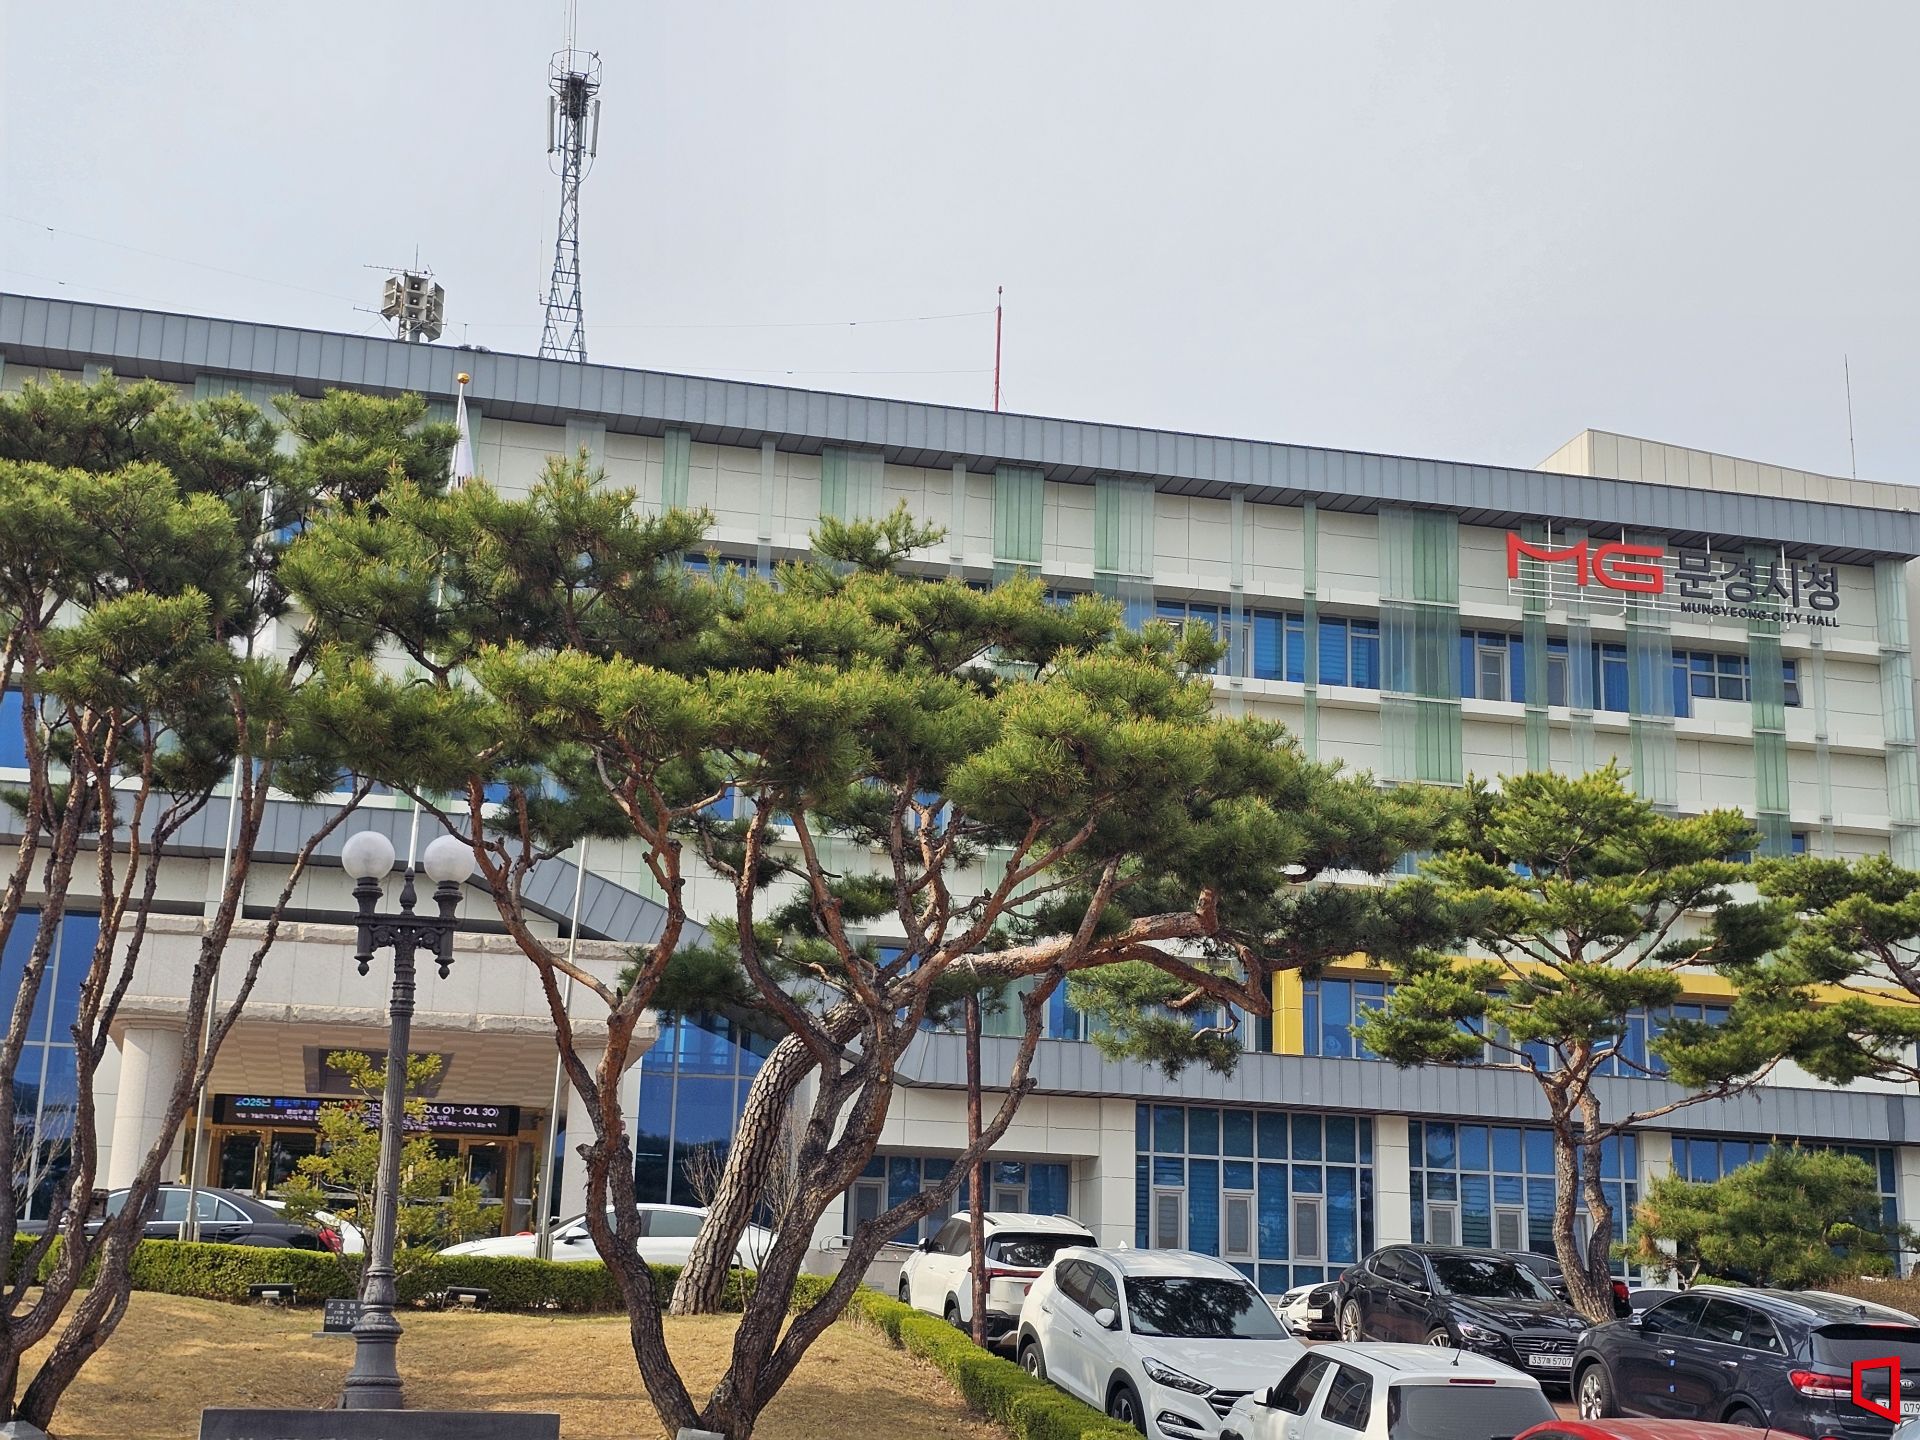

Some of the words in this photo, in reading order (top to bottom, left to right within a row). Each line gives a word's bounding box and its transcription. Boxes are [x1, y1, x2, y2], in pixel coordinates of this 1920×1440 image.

[1507, 531, 1664, 593] MG
[1675, 550, 1840, 611] 문경시청
[1680, 602, 1767, 620] MUNGYEONG
[1771, 612, 1803, 623] CITY
[1806, 615, 1840, 628] HALL
[235, 1097, 271, 1108] 2025년
[1552, 1357, 1572, 1366] 5707
